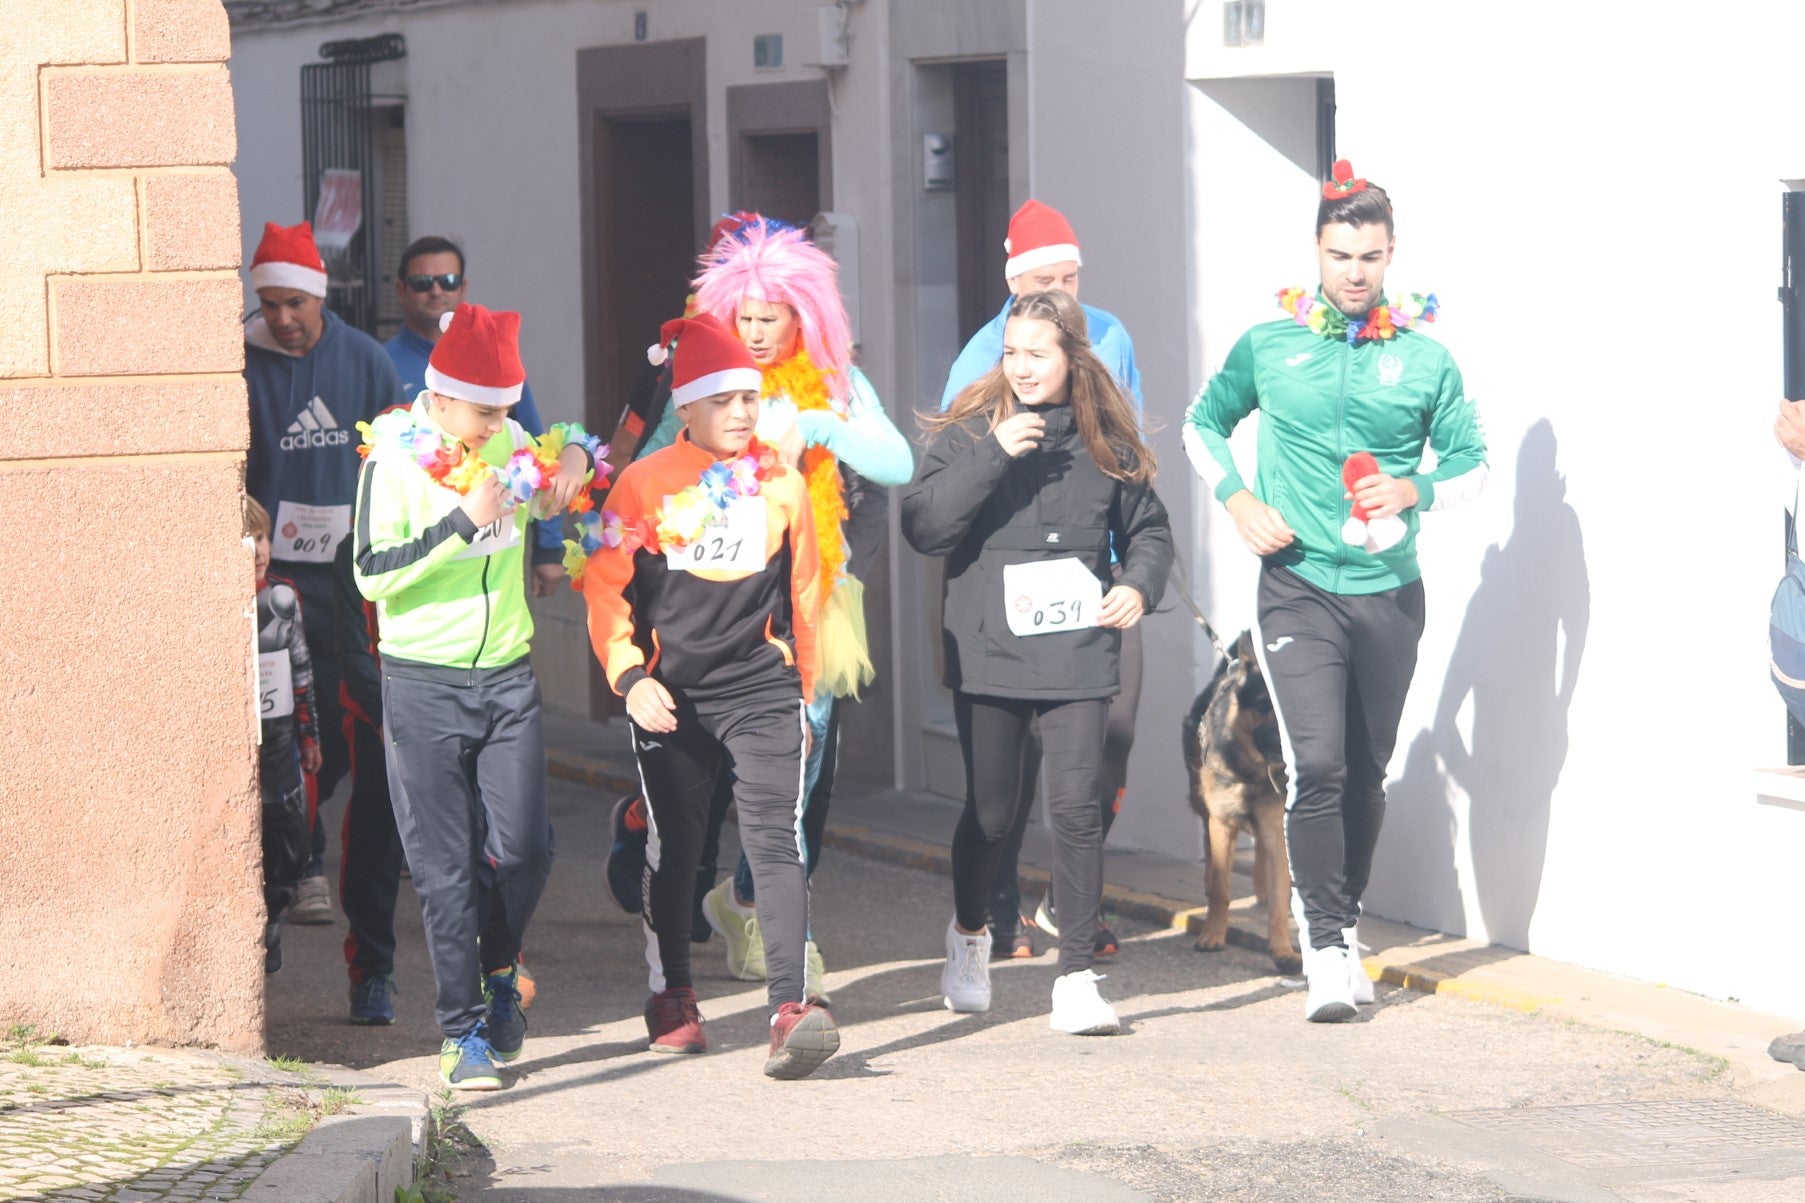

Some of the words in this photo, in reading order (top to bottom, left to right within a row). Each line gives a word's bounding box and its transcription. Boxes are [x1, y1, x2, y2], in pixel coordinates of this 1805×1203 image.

[280, 429, 349, 451] adidas
[292, 533, 332, 554] 009
[693, 537, 743, 562] 021
[1033, 600, 1082, 626] 039
